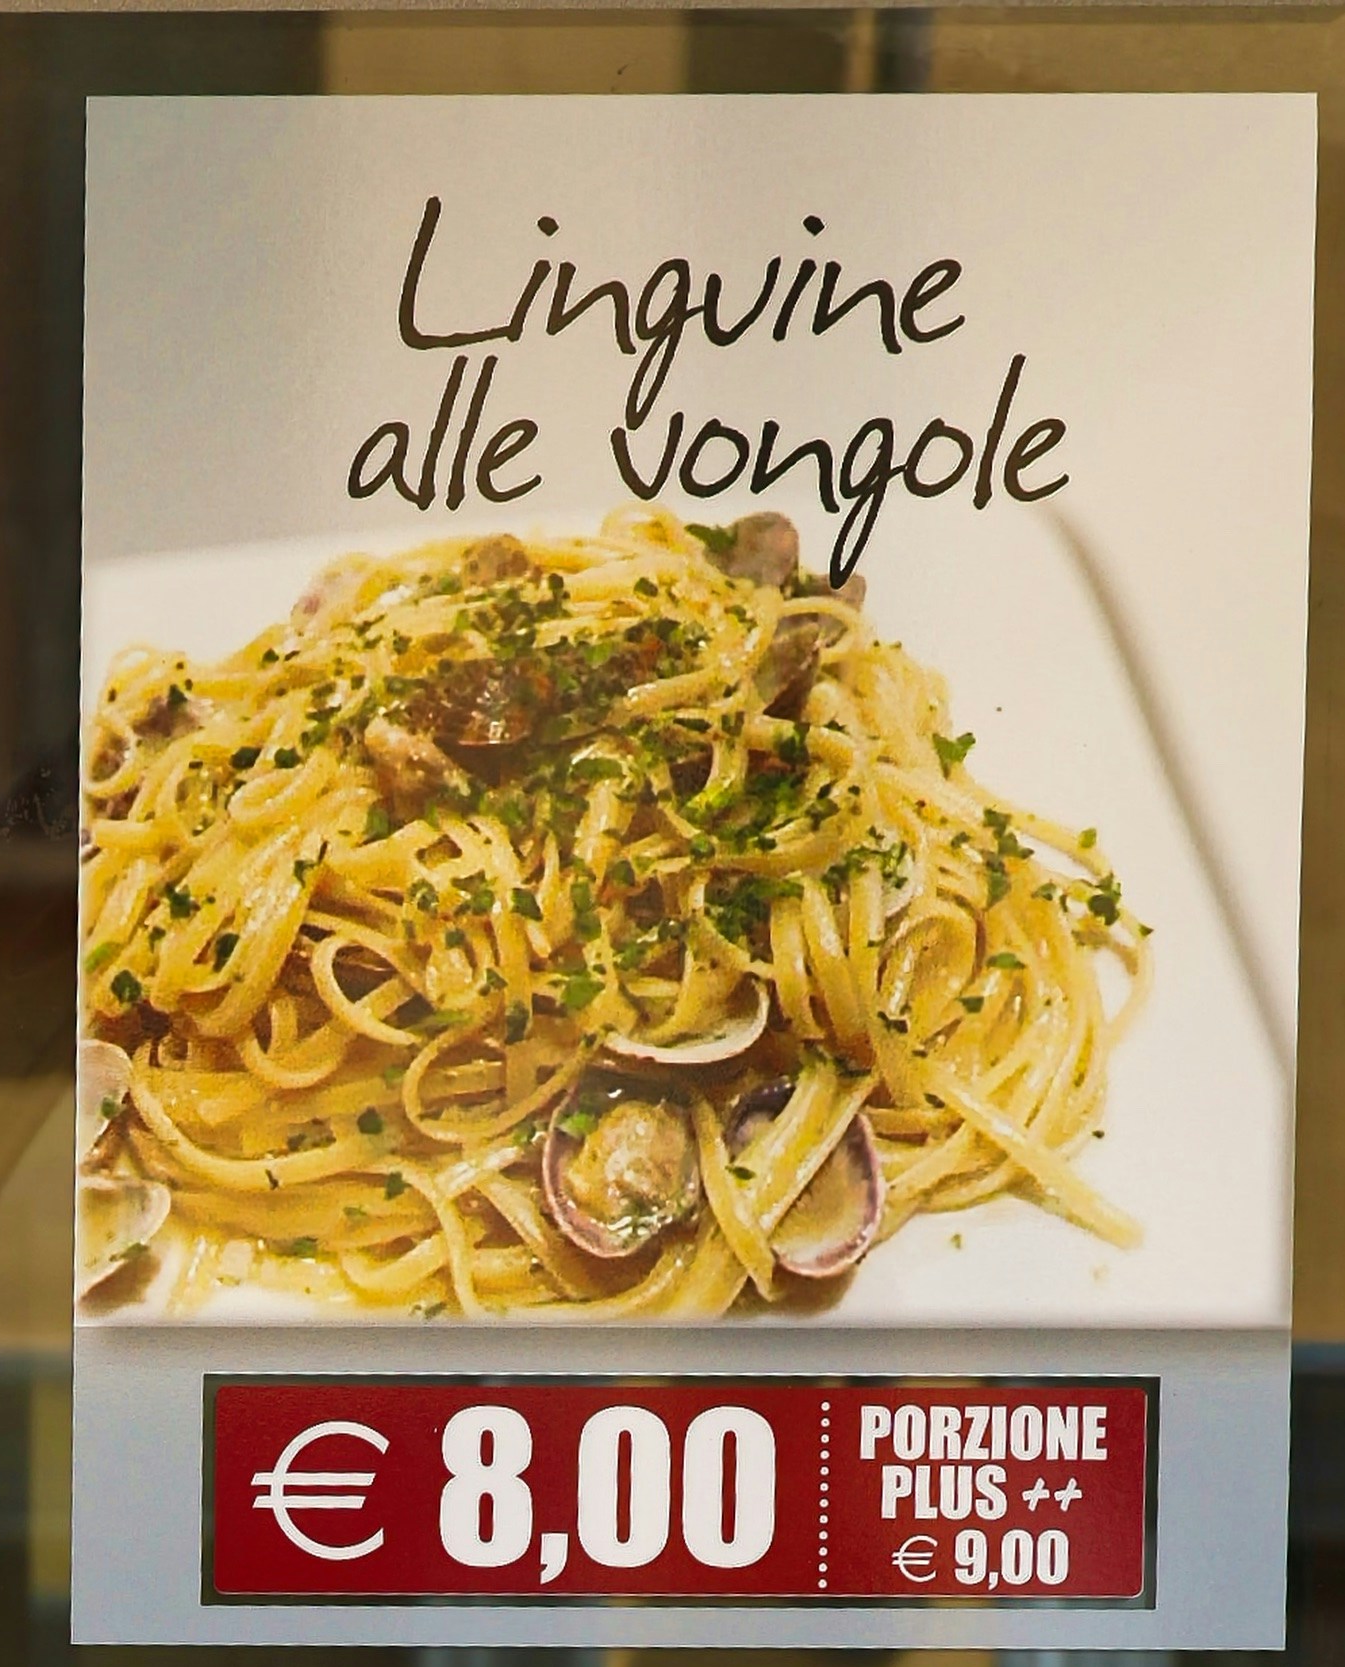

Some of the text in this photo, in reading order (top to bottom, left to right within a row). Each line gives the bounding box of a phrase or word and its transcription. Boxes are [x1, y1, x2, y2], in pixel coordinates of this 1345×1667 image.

[398, 196, 966, 423] Linguine
[348, 356, 1069, 588] alle vongole
[860, 1405, 1107, 1460] PORZIONE
[251, 1406, 775, 1584] € 8,00
[882, 1465, 1082, 1520] PLUS ++
[892, 1530, 1068, 1590] € 9,00
